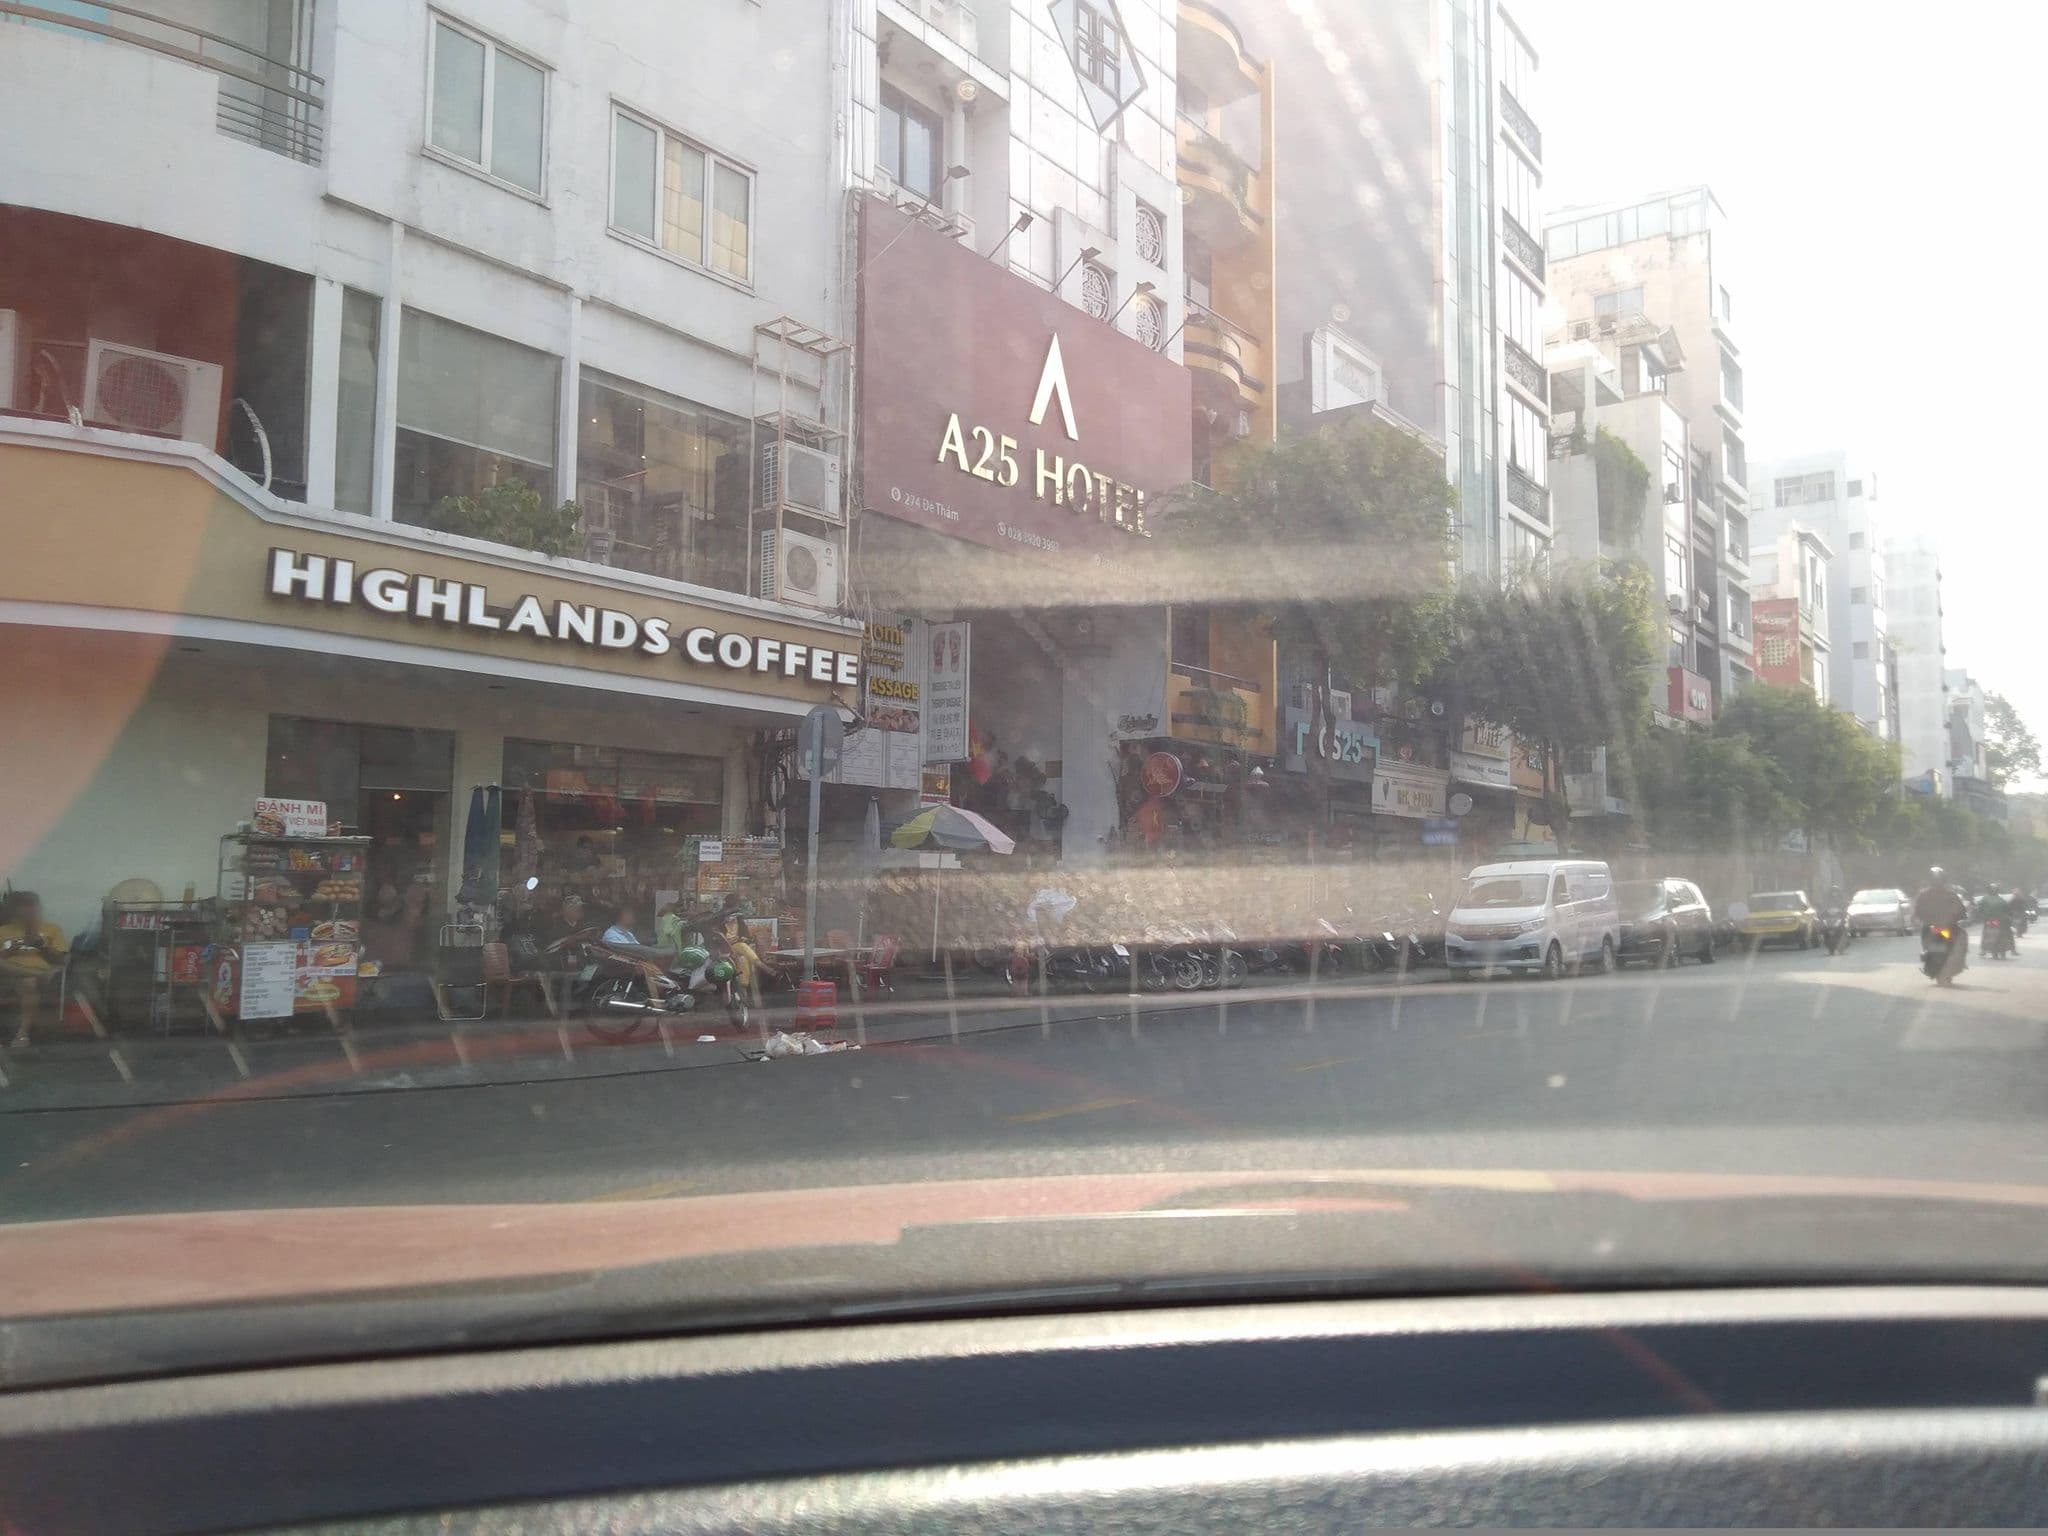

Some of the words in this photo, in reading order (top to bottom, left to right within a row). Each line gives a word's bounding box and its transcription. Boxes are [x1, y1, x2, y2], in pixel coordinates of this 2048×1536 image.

[937, 412, 1020, 489] A25
[1035, 447, 1152, 538] HOTEL
[270, 546, 671, 656] HIGHLANDS
[685, 627, 860, 688] COFFEE
